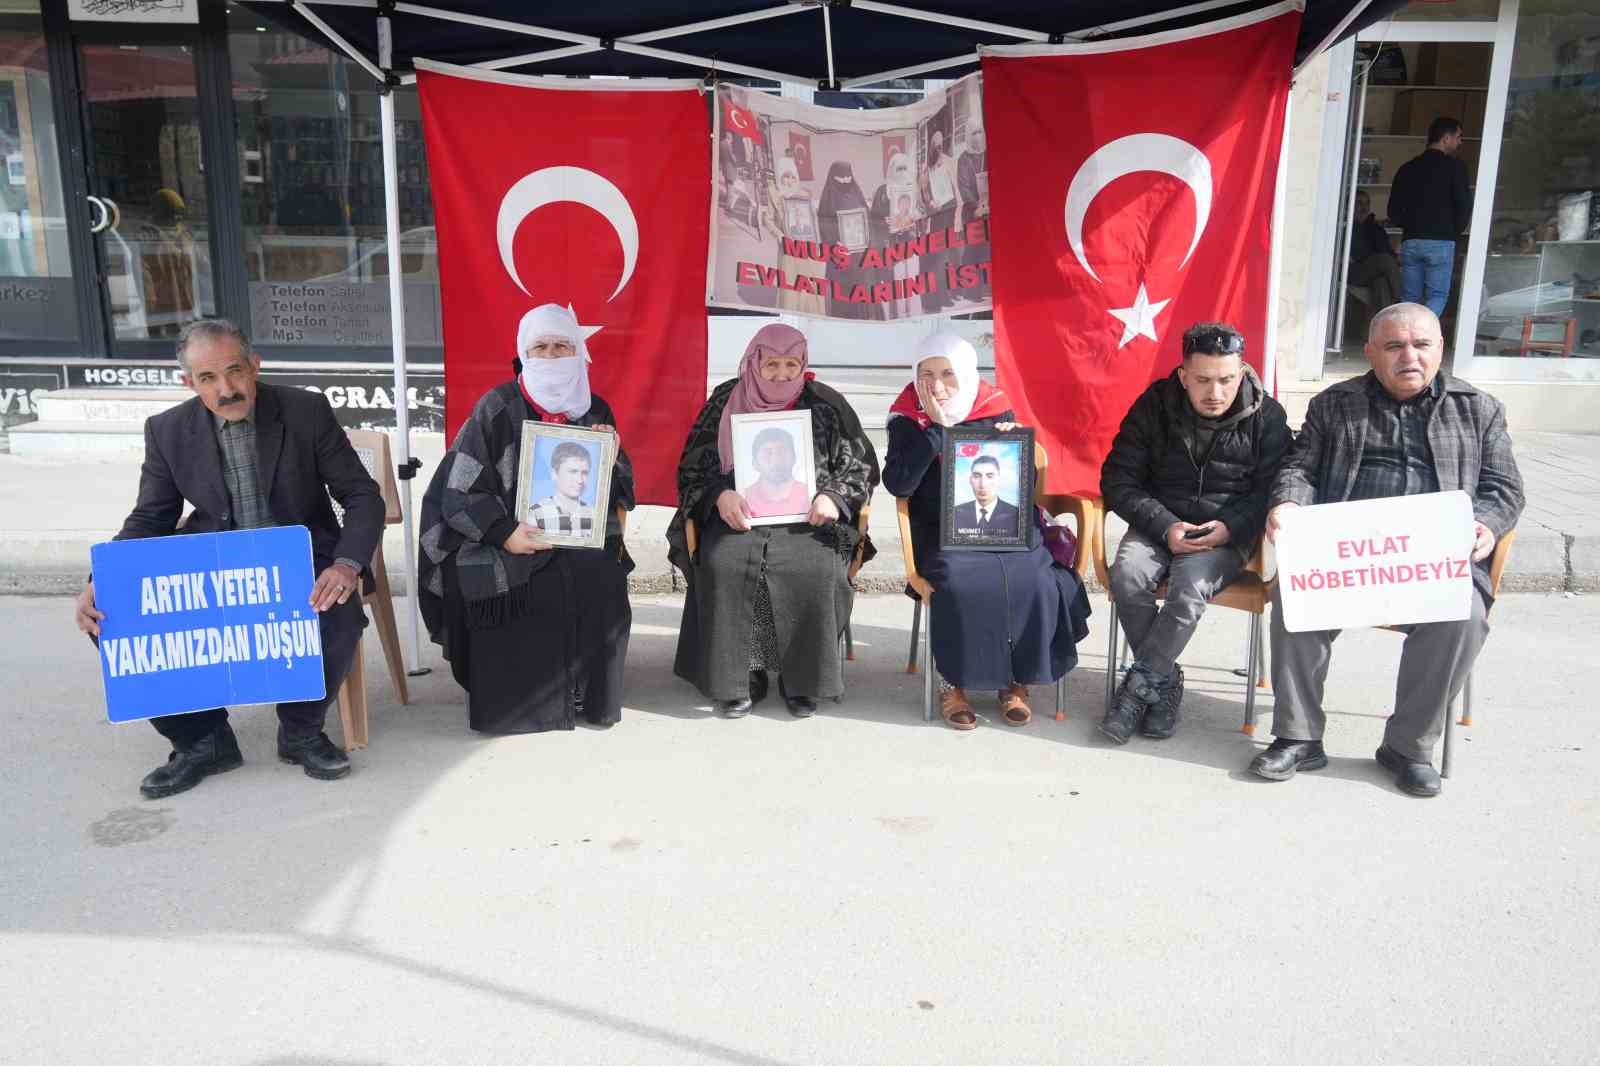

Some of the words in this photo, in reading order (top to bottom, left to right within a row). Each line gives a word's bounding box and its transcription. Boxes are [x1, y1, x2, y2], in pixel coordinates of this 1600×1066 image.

[782, 236, 850, 270] MUŞ
[860, 217, 990, 270] ANNELE
[270, 285, 326, 297] Telefon
[736, 261, 937, 304] EVLATLARINI
[271, 300, 327, 312] Telefon
[272, 315, 328, 327] Telefon
[272, 328, 304, 342] Mp3
[1337, 535, 1411, 559] EVLAT
[1290, 556, 1470, 592] NÖBETİNDEYİZ
[141, 572, 208, 616] ARTIK
[210, 566, 270, 608] YETER
[103, 624, 250, 678] YAKAMIZDAN
[254, 610, 321, 669] DÜŞÜN
